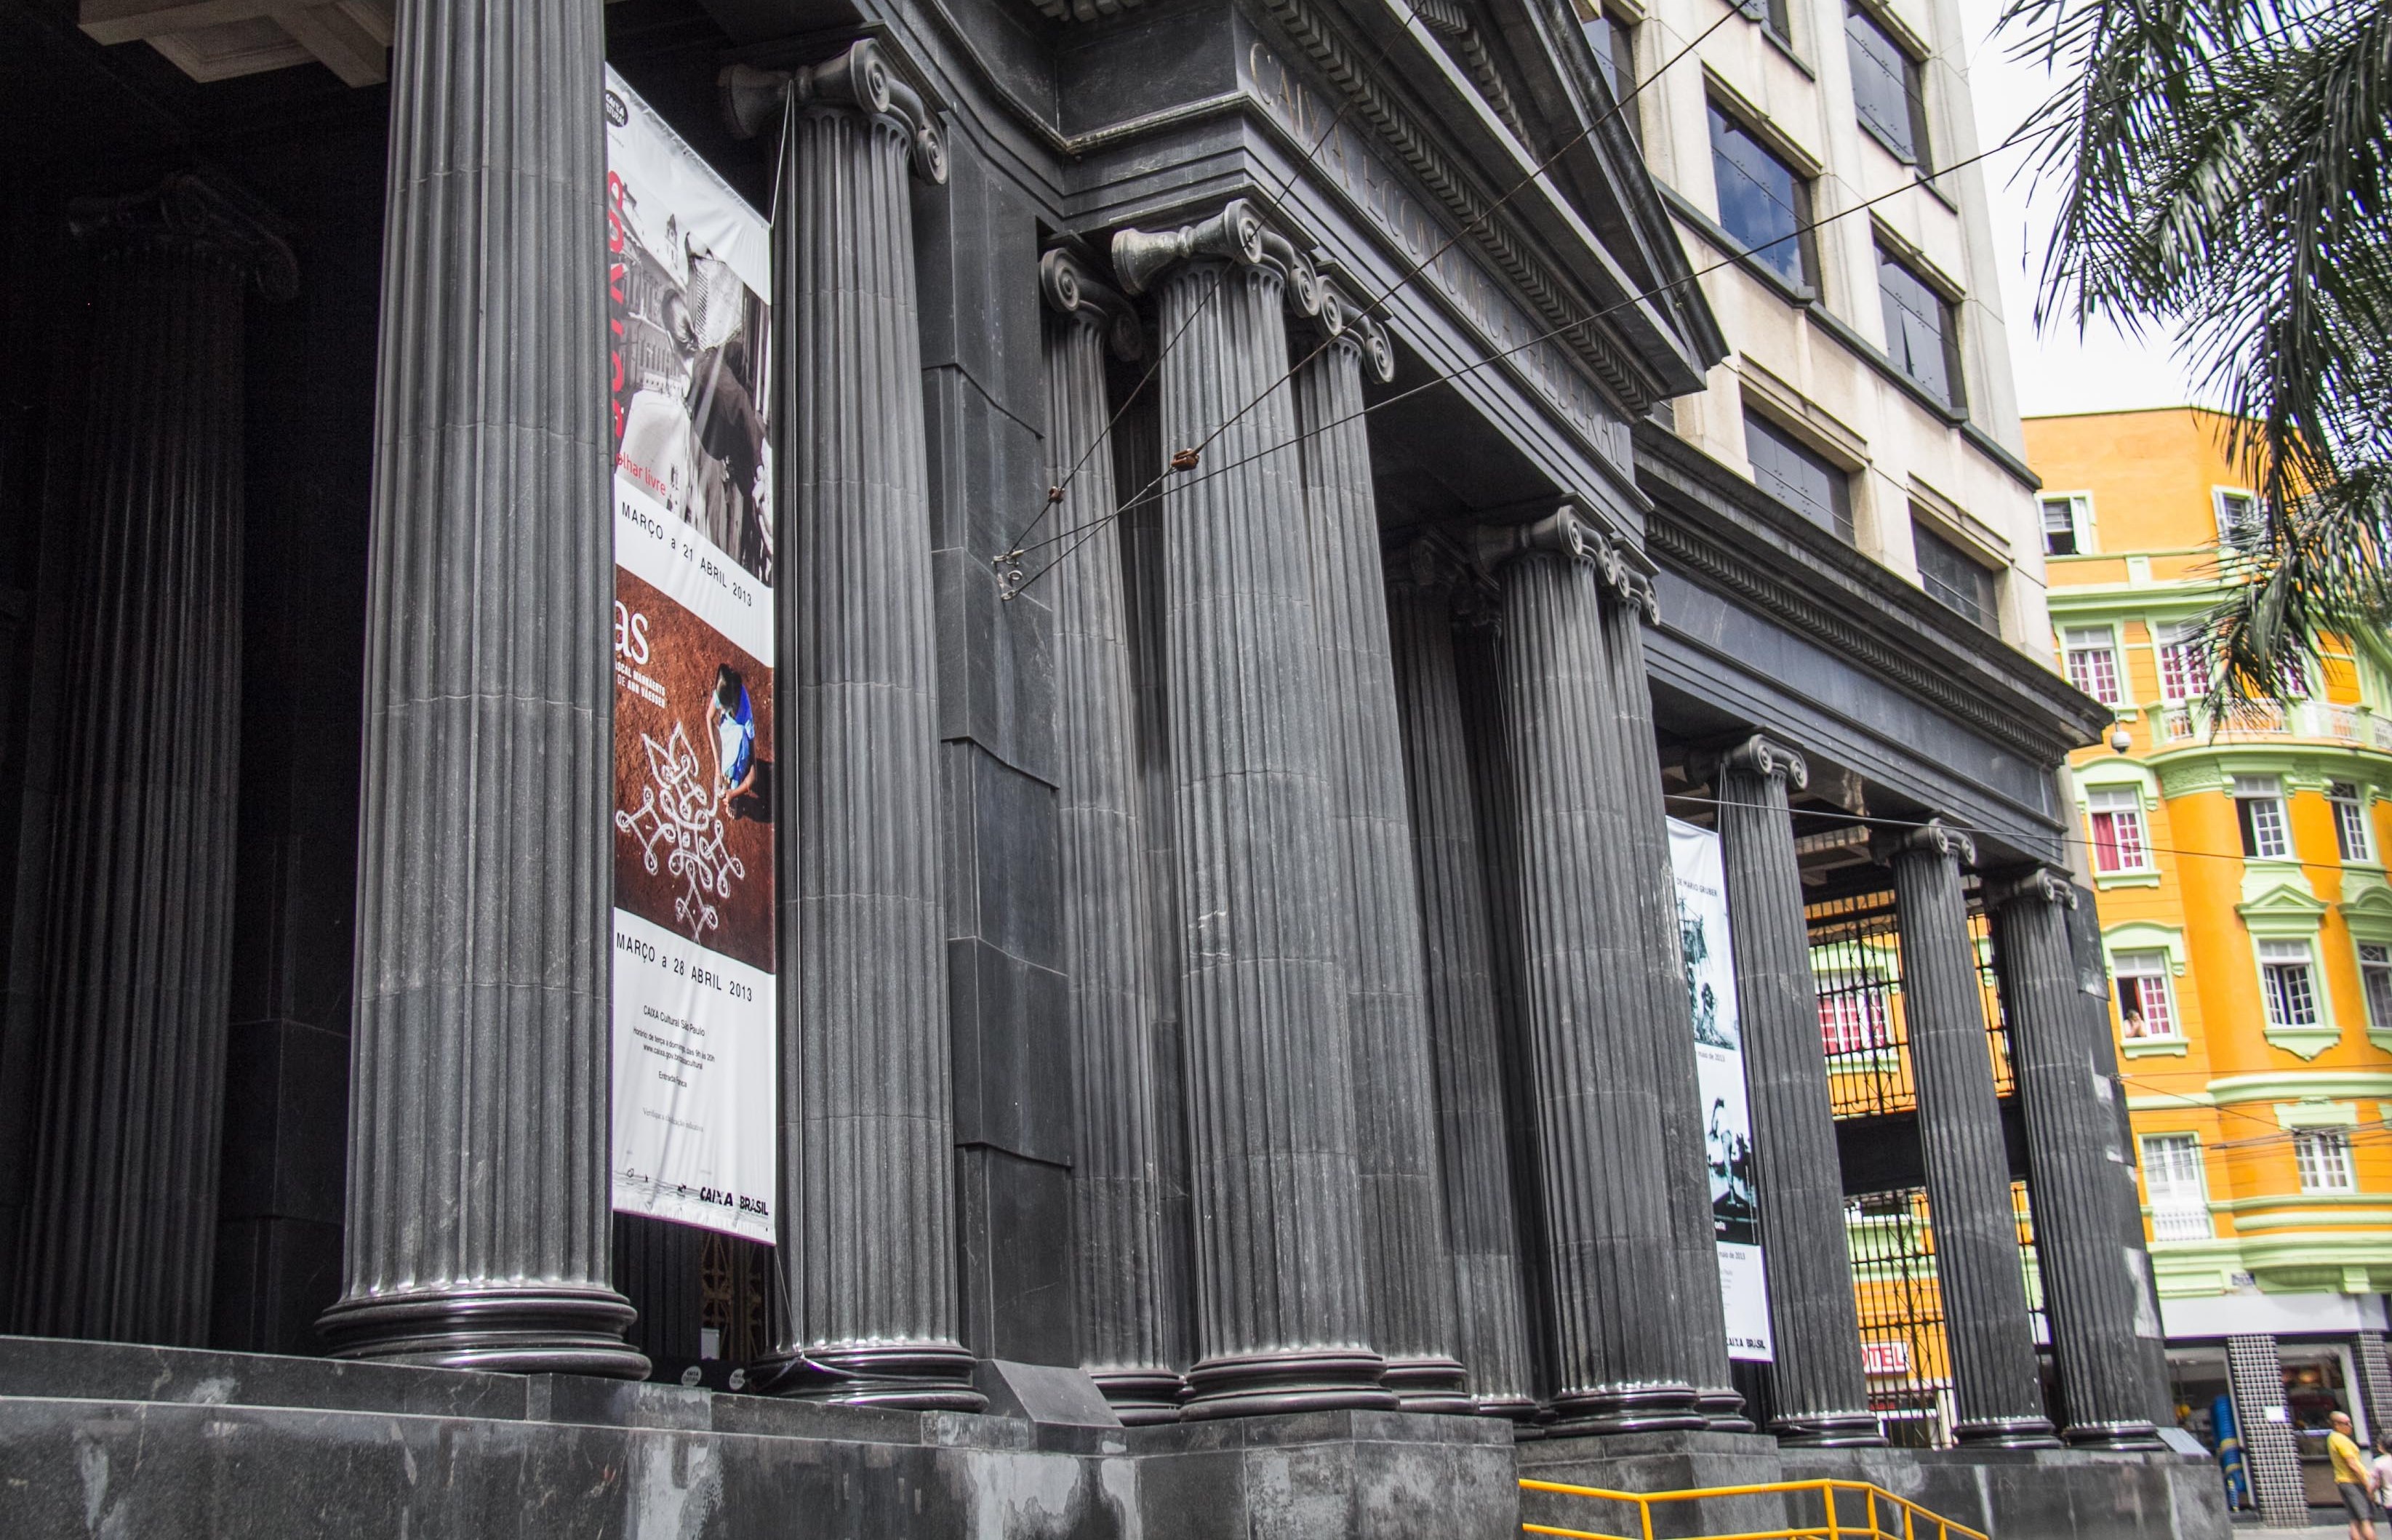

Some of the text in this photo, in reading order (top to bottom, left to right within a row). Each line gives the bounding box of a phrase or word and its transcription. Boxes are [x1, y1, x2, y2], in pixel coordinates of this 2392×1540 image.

[1250, 42, 1350, 190] CAIXA
[1524, 324, 1626, 473] FEDERAL
[616, 452, 666, 496] olhar livre
[623, 502, 752, 607] MARÇO a 21 ABRIL 2013
[616, 661, 632, 678] SCAL
[617, 674, 625, 687] DE
[617, 932, 753, 1002] MARÇO a 28 ABRIL 2013
[643, 1005, 659, 1021] CAIXA
[660, 1011, 680, 1028] Cultural
[689, 1022, 705, 1037] Paulo
[700, 1186, 769, 1216] CAIXA BRASIL
[1861, 1345, 1905, 1367] OTEL
